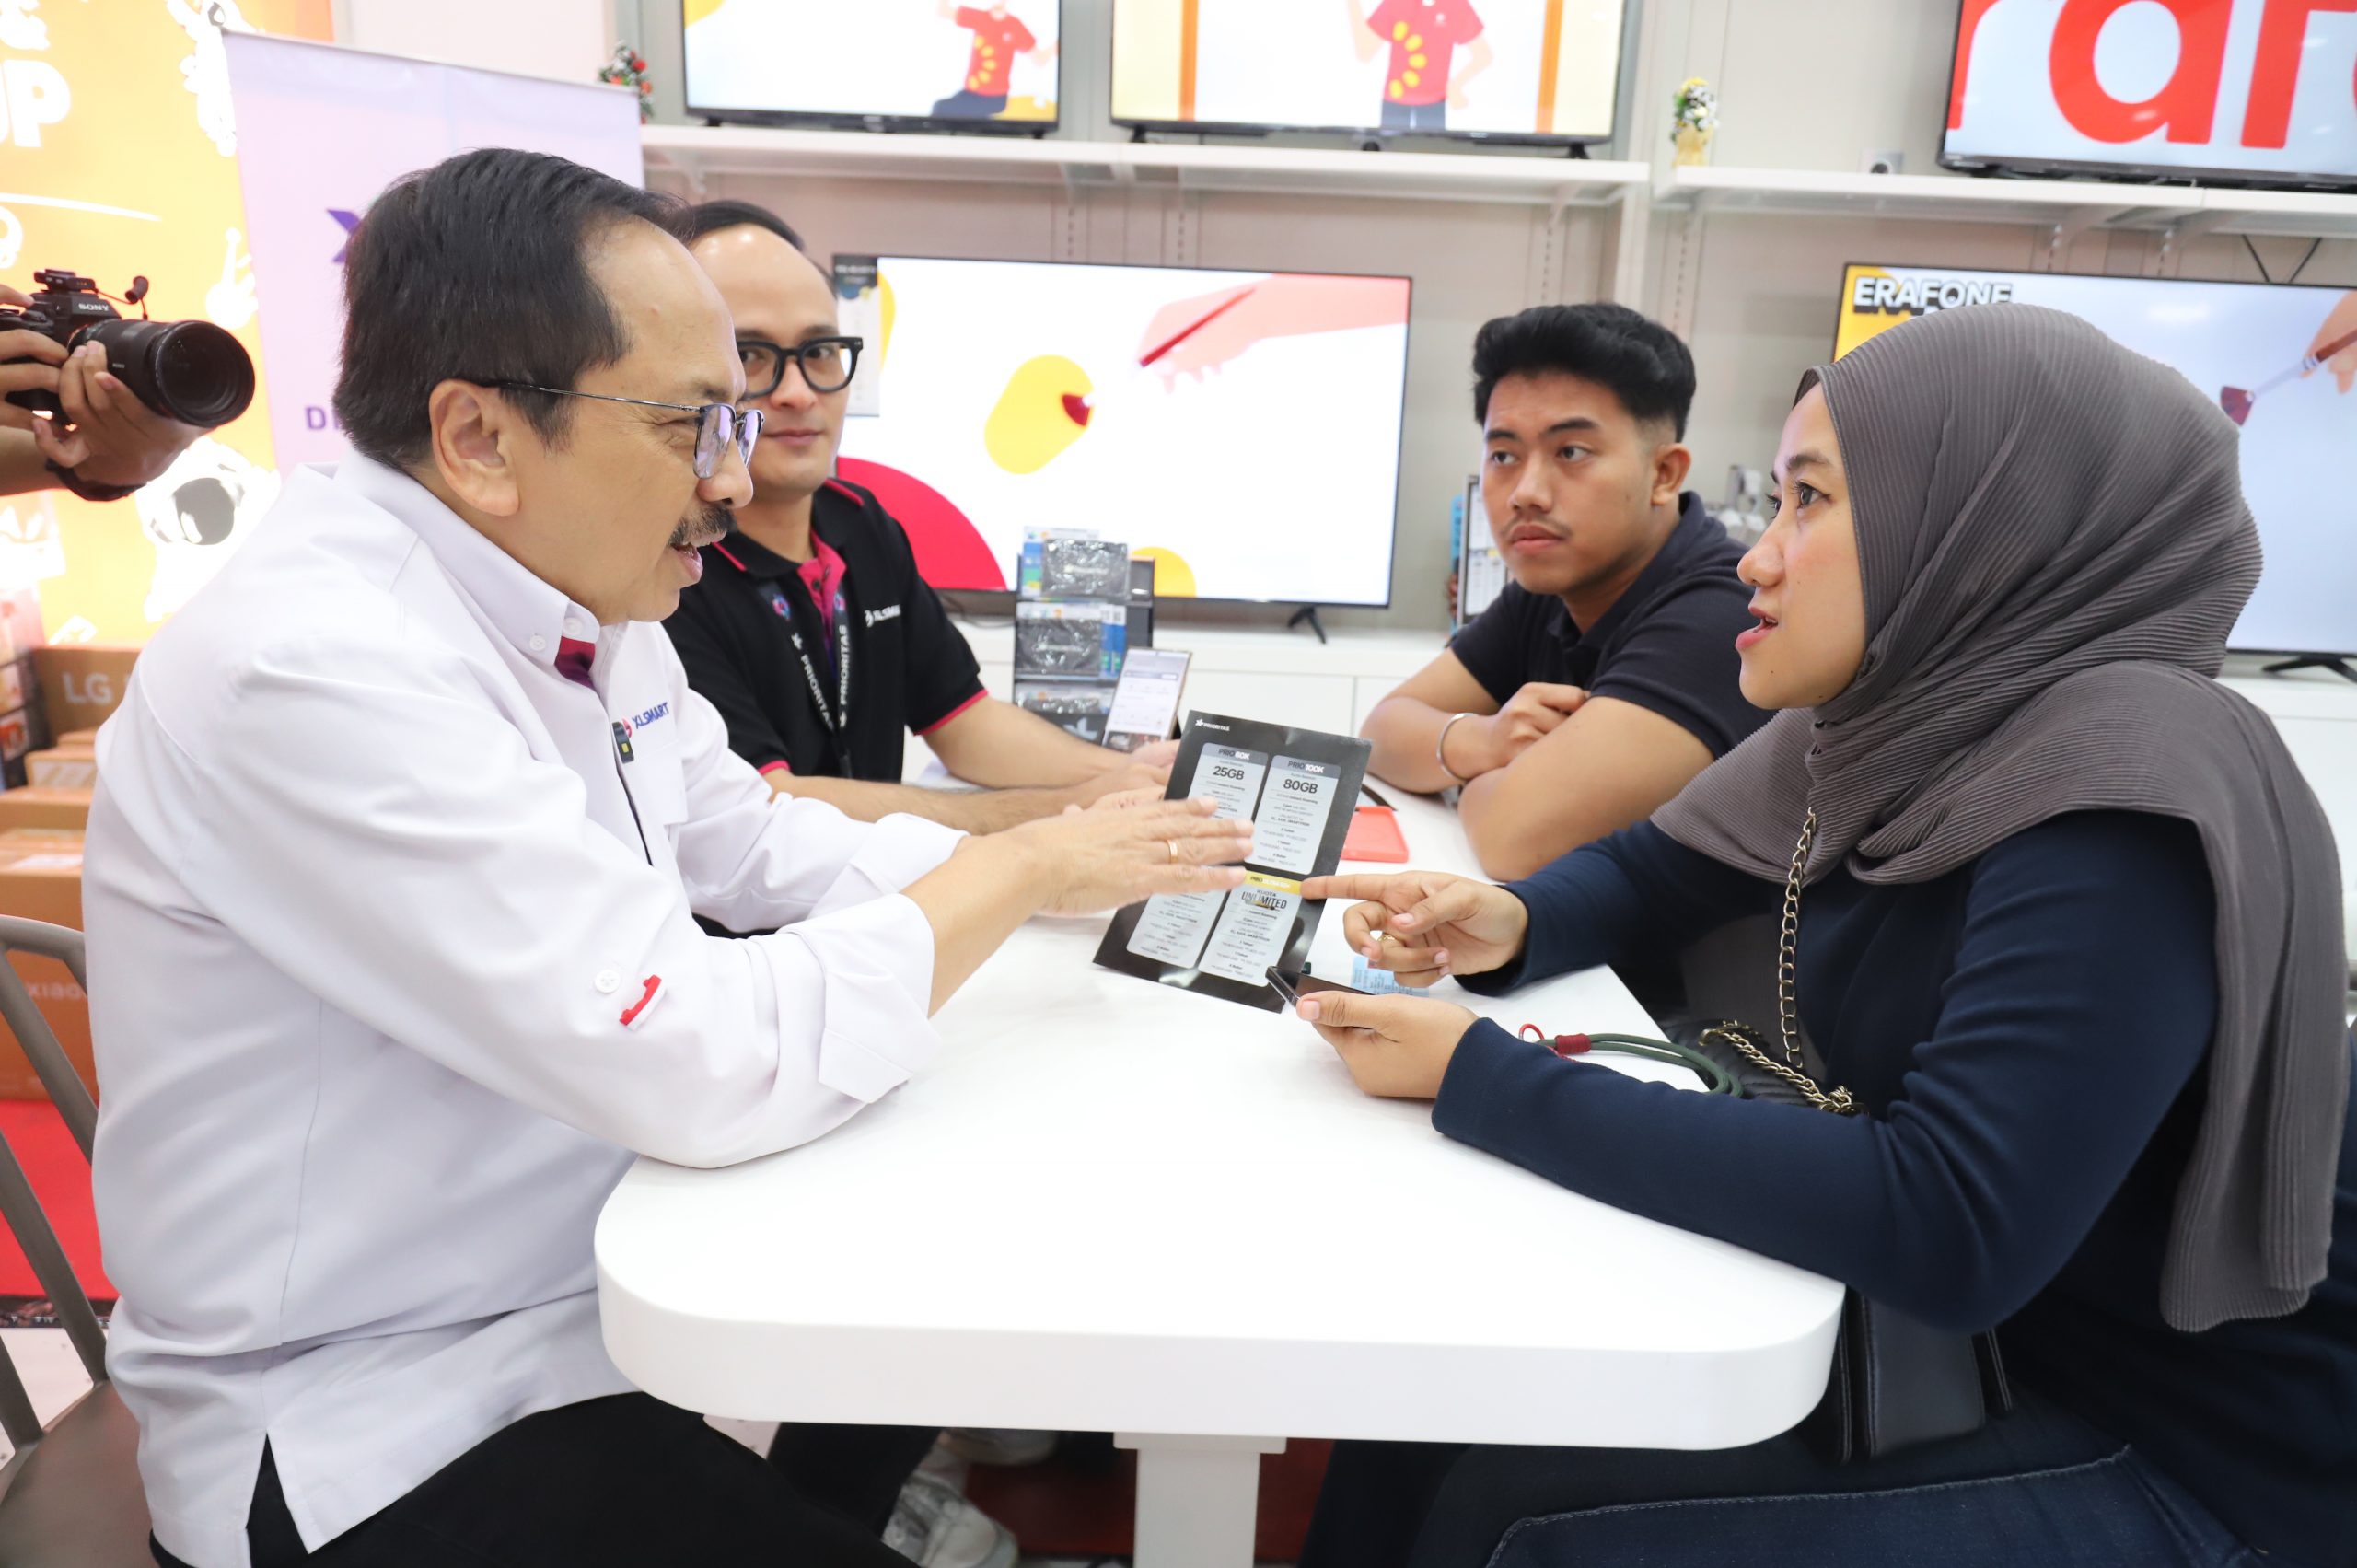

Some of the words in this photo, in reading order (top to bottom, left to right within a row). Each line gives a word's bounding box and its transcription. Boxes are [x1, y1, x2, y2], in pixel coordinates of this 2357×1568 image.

[0, 58, 71, 147] P
[1853, 276, 2013, 314] ERAFONE
[78, 303, 109, 311] SONY
[839, 624, 849, 705] PRIORITAS
[62, 671, 114, 705] LG
[632, 701, 669, 729] XLSMART
[1218, 748, 1235, 757] PRIO
[1213, 765, 1245, 781] 25GB
[1288, 761, 1306, 771] PRIO
[1306, 763, 1325, 774] 100K
[1283, 778, 1318, 794] 80GB
[1241, 891, 1288, 910] UNLIMITED
